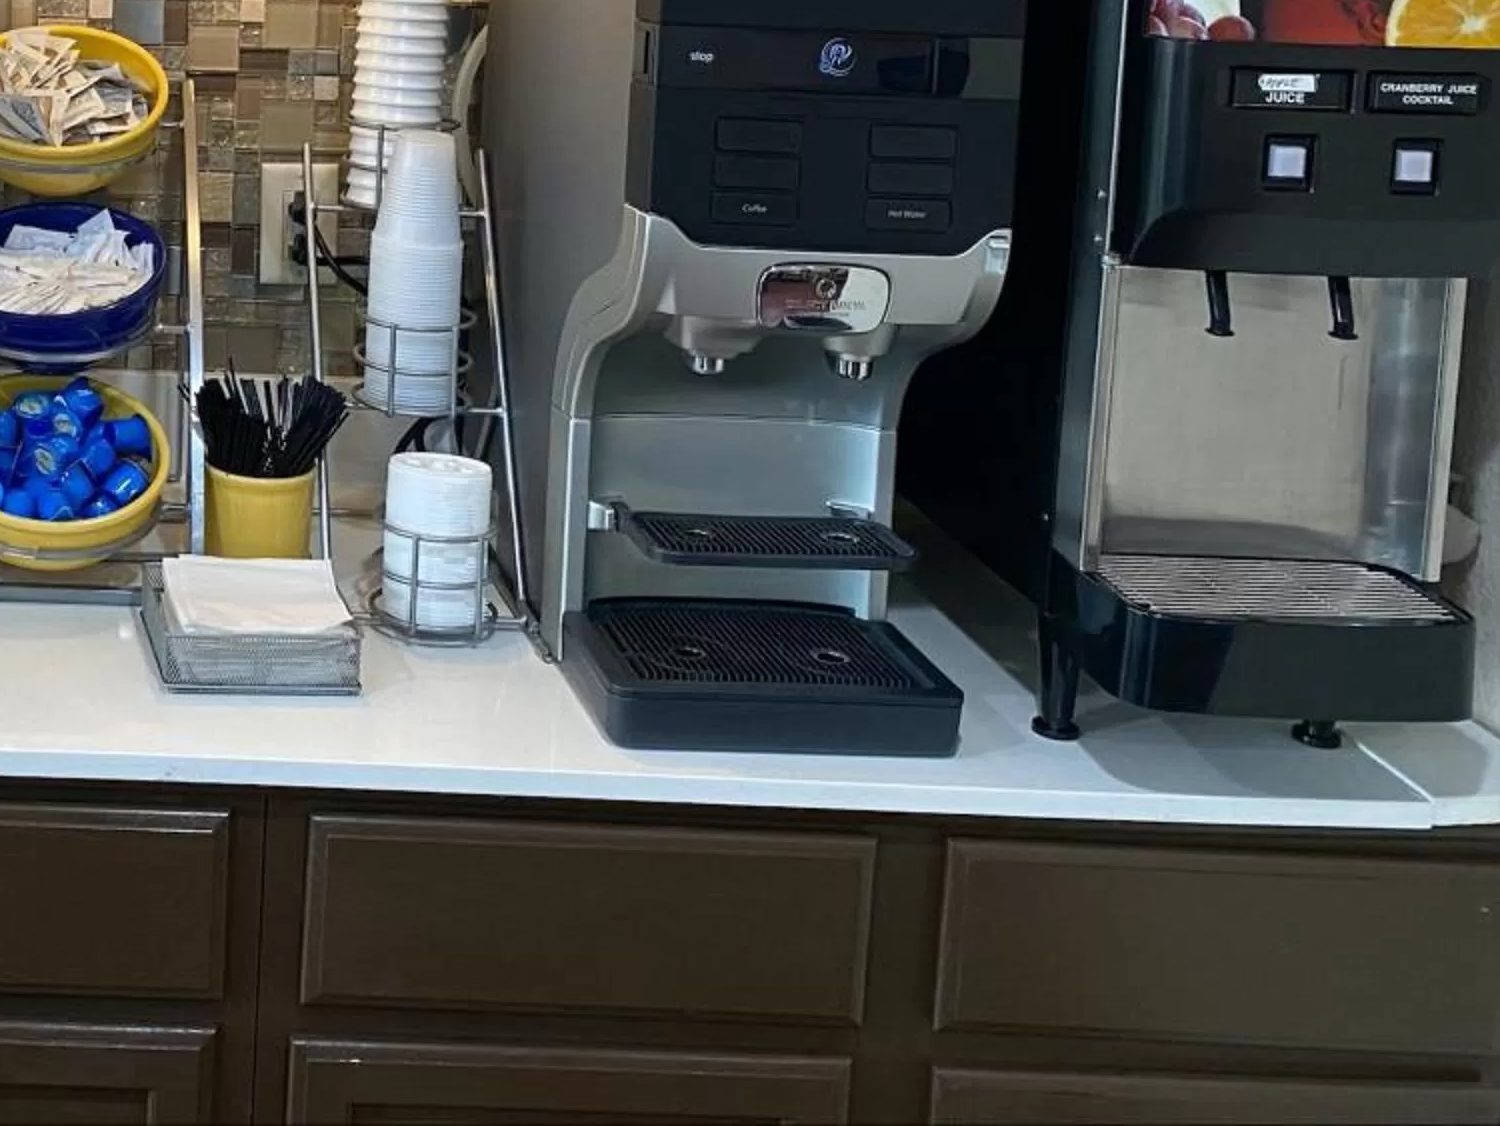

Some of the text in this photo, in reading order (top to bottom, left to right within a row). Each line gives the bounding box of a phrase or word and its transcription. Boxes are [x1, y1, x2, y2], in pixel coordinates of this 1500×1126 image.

[1380, 82, 1477, 94] CRANBERRY JUICE
[1265, 91, 1305, 103] JUICE
[1402, 94, 1453, 105] COCKTAIL
